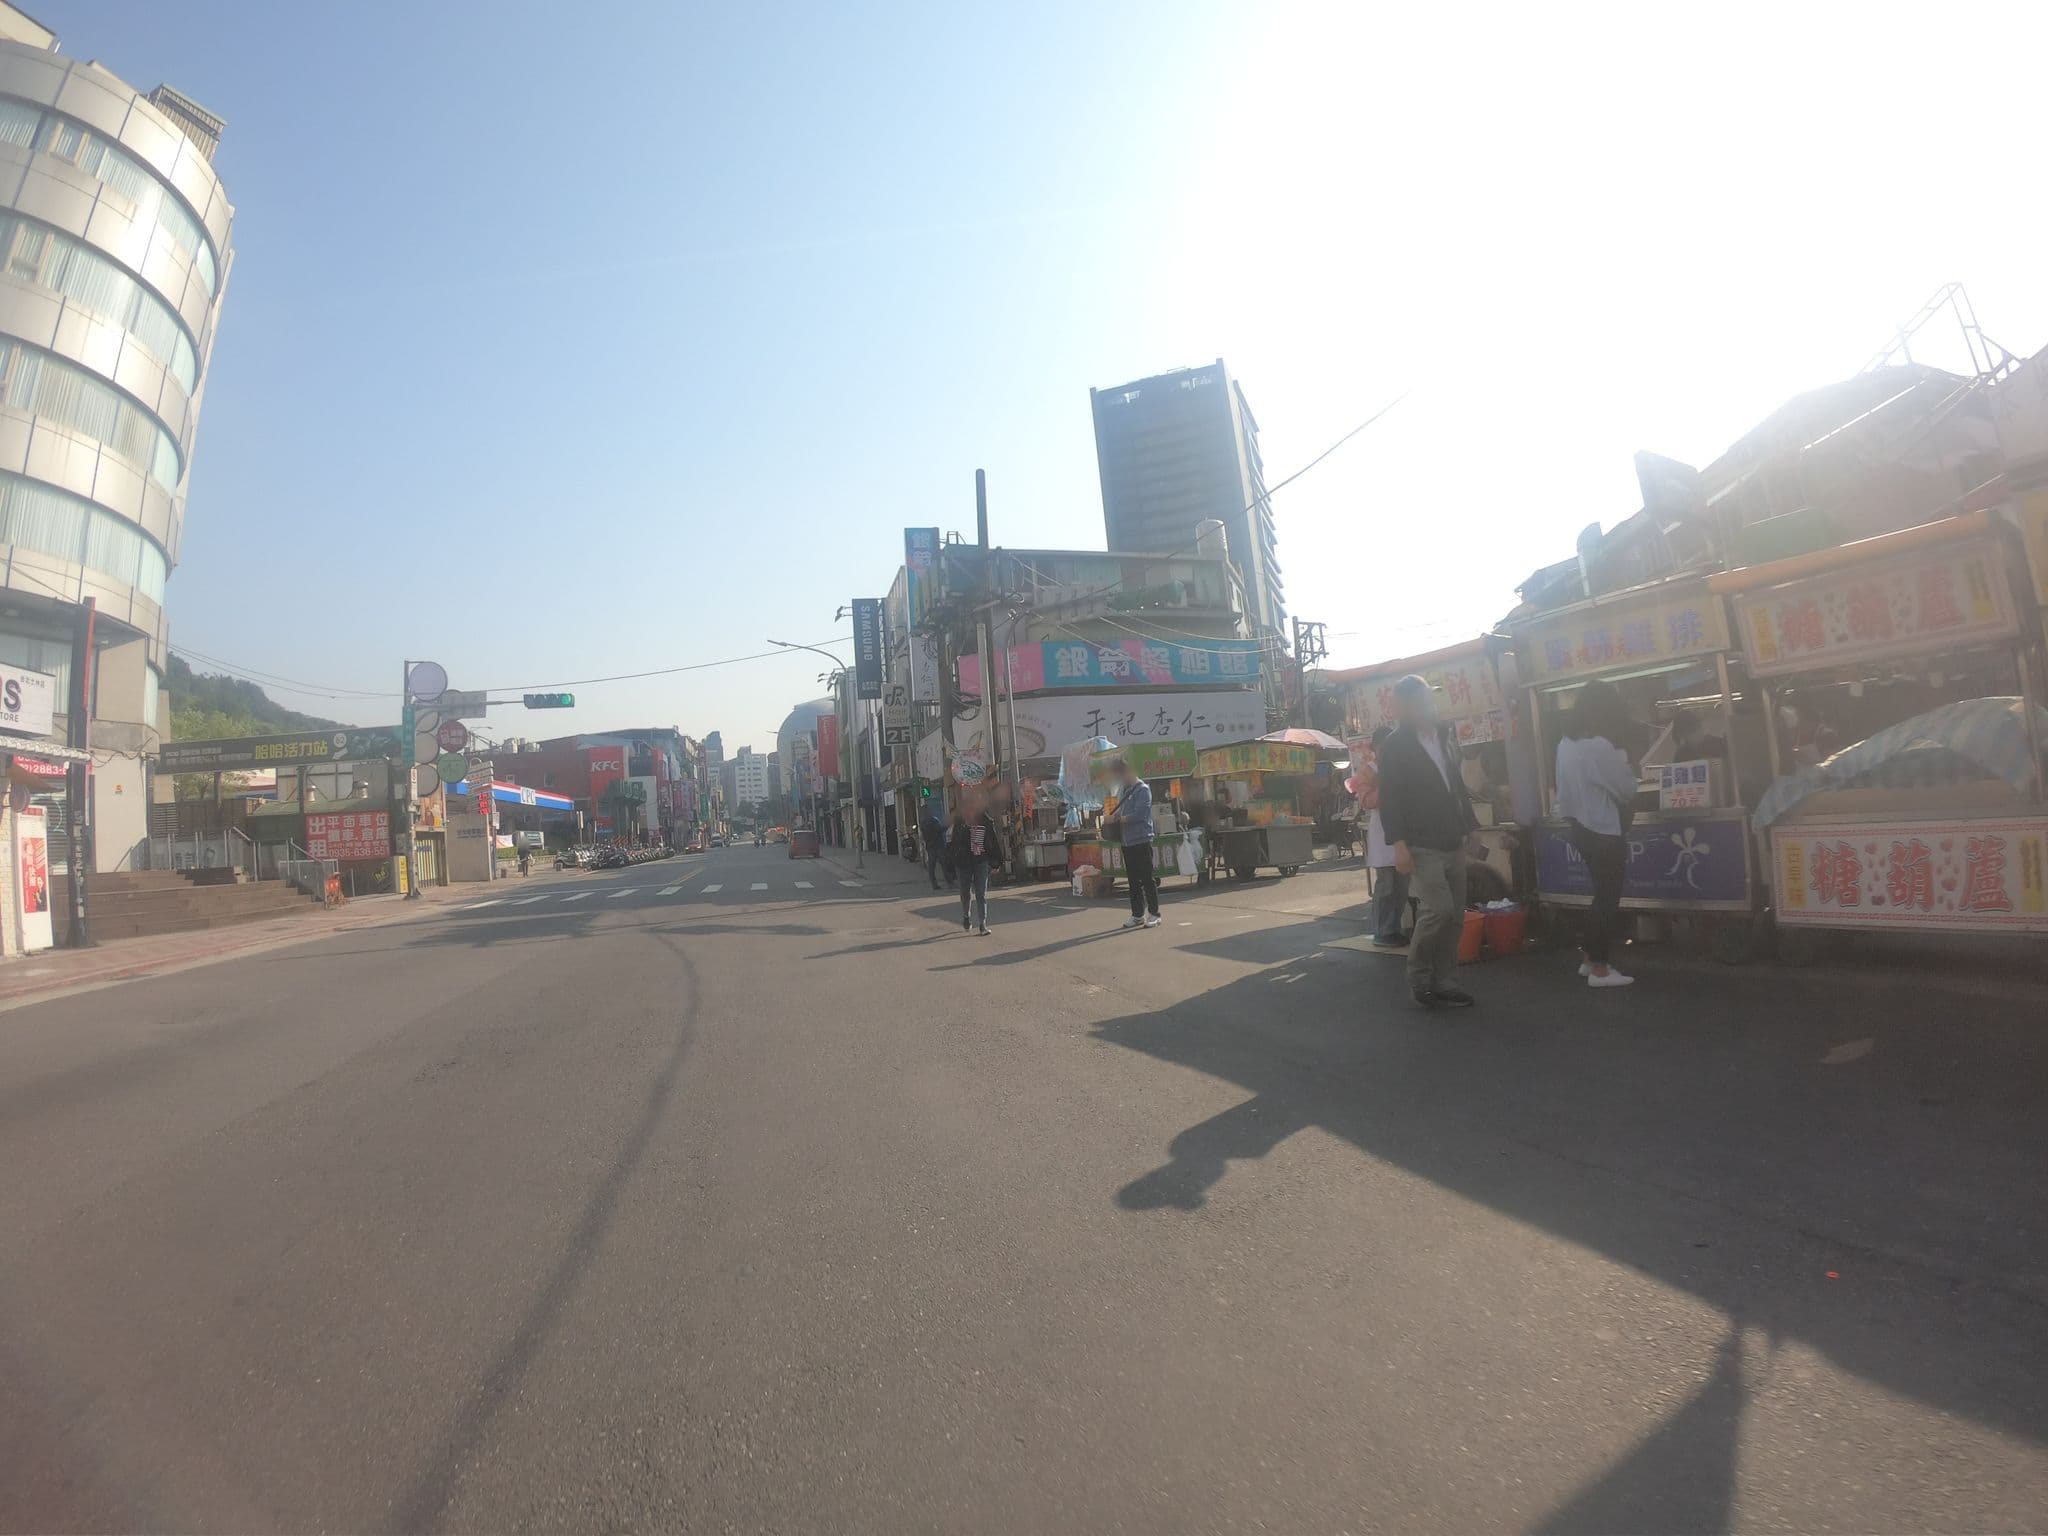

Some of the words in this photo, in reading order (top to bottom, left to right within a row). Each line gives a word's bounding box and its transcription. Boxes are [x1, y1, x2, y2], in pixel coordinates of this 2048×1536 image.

[860, 605, 873, 661] SAMSUNG
[0, 677, 21, 713] S
[887, 729, 911, 743] 2F
[591, 760, 620, 773] KFC
[308, 816, 328, 858] 出租
[1810, 836, 2013, 912] 糖葫蘆
